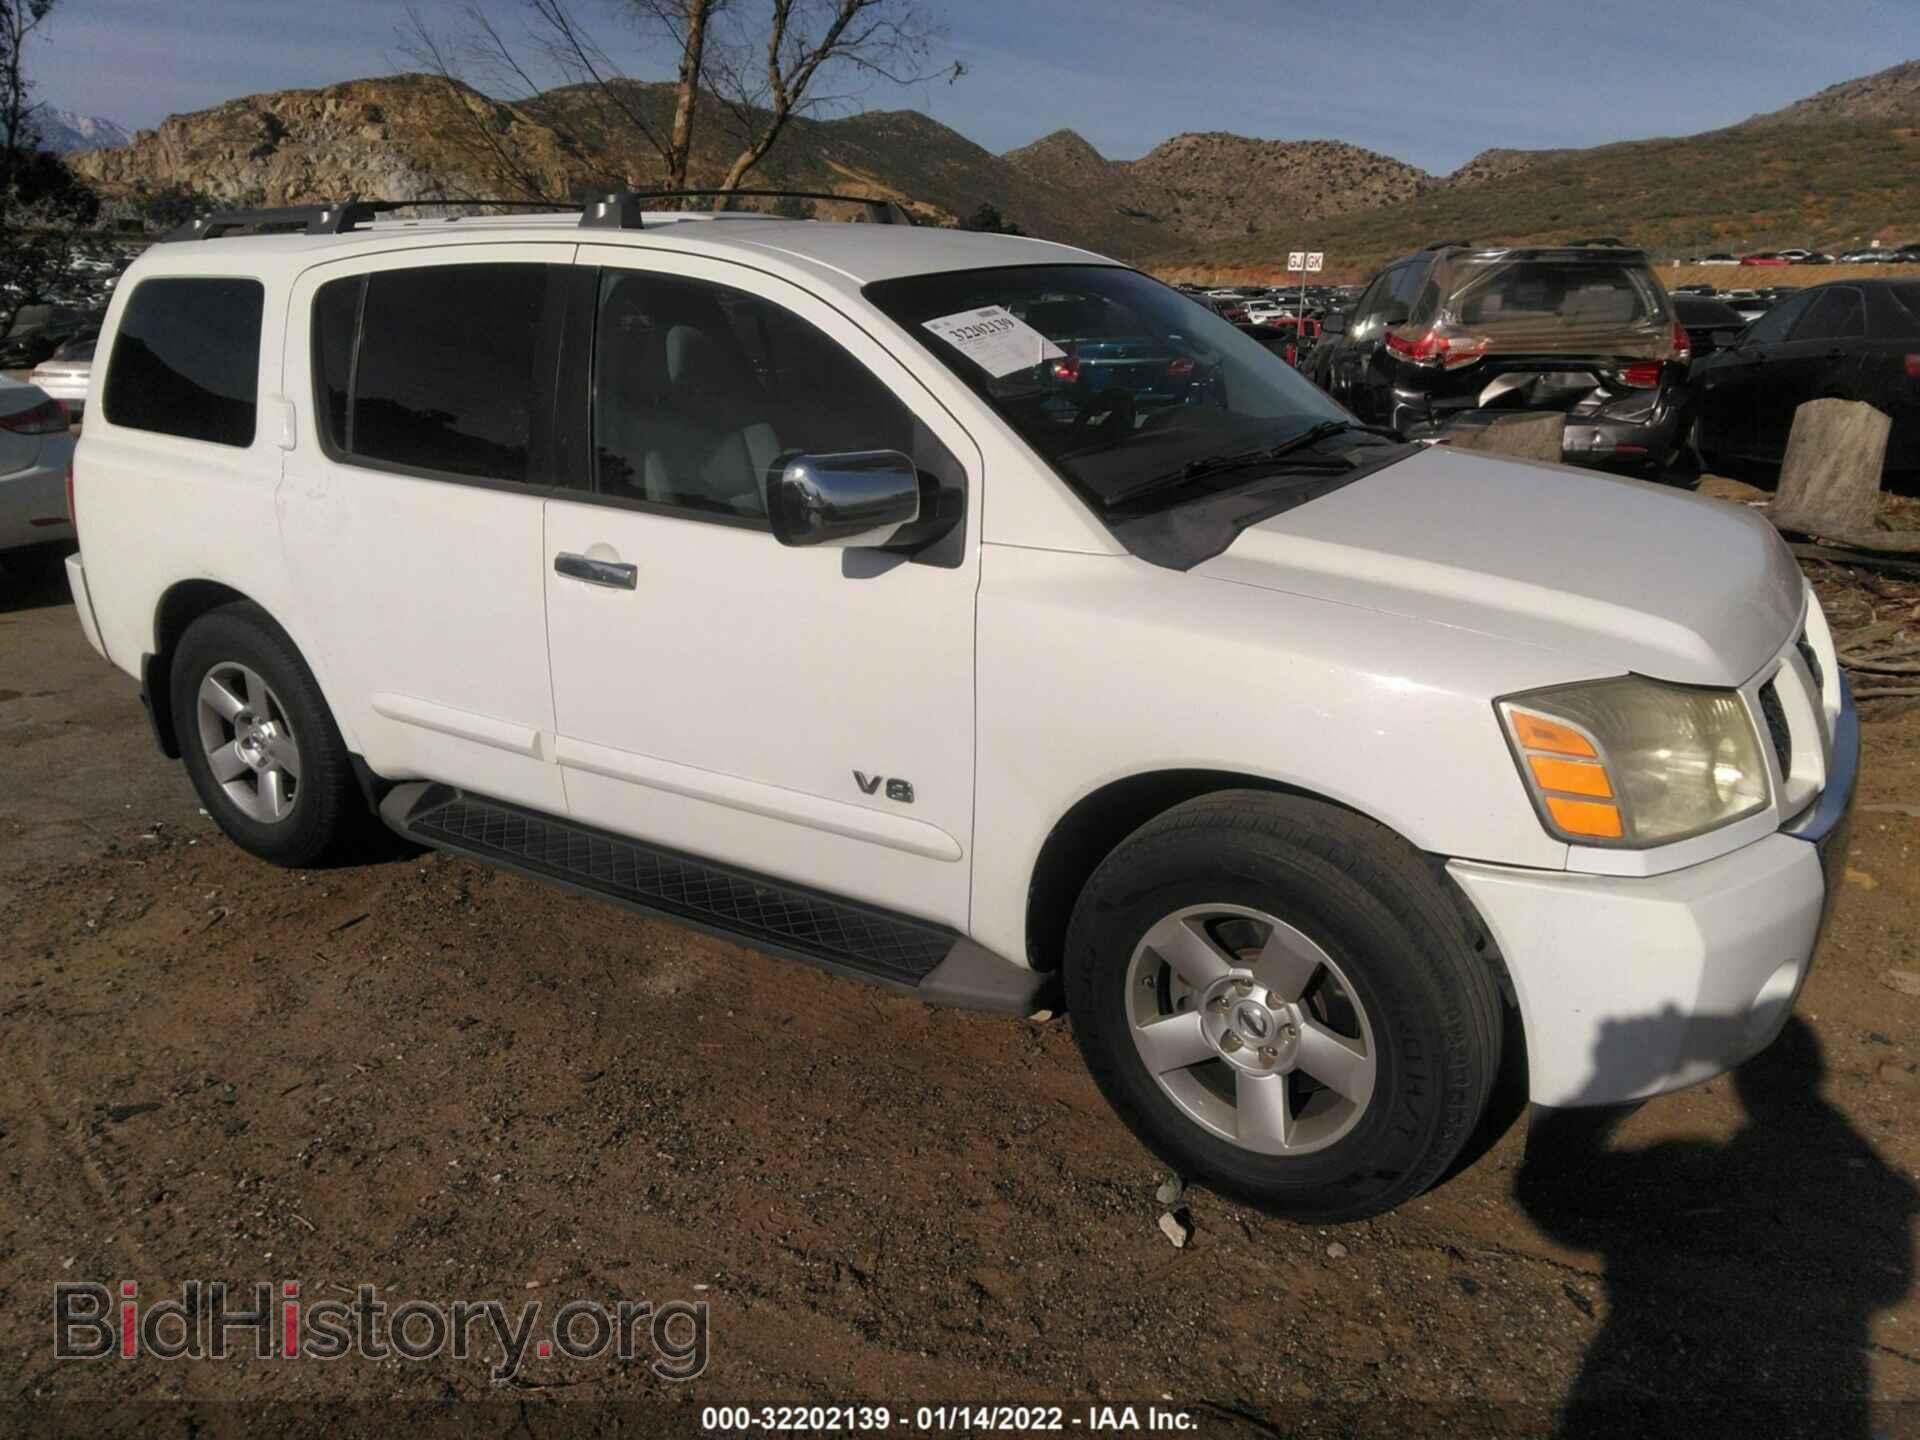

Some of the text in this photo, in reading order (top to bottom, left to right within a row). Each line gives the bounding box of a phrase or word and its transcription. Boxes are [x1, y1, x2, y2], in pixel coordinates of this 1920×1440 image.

[1290, 254, 1304, 269] GJ
[1308, 254, 1322, 269] GK
[948, 317, 1015, 342] 32202139
[852, 769, 915, 804] V8
